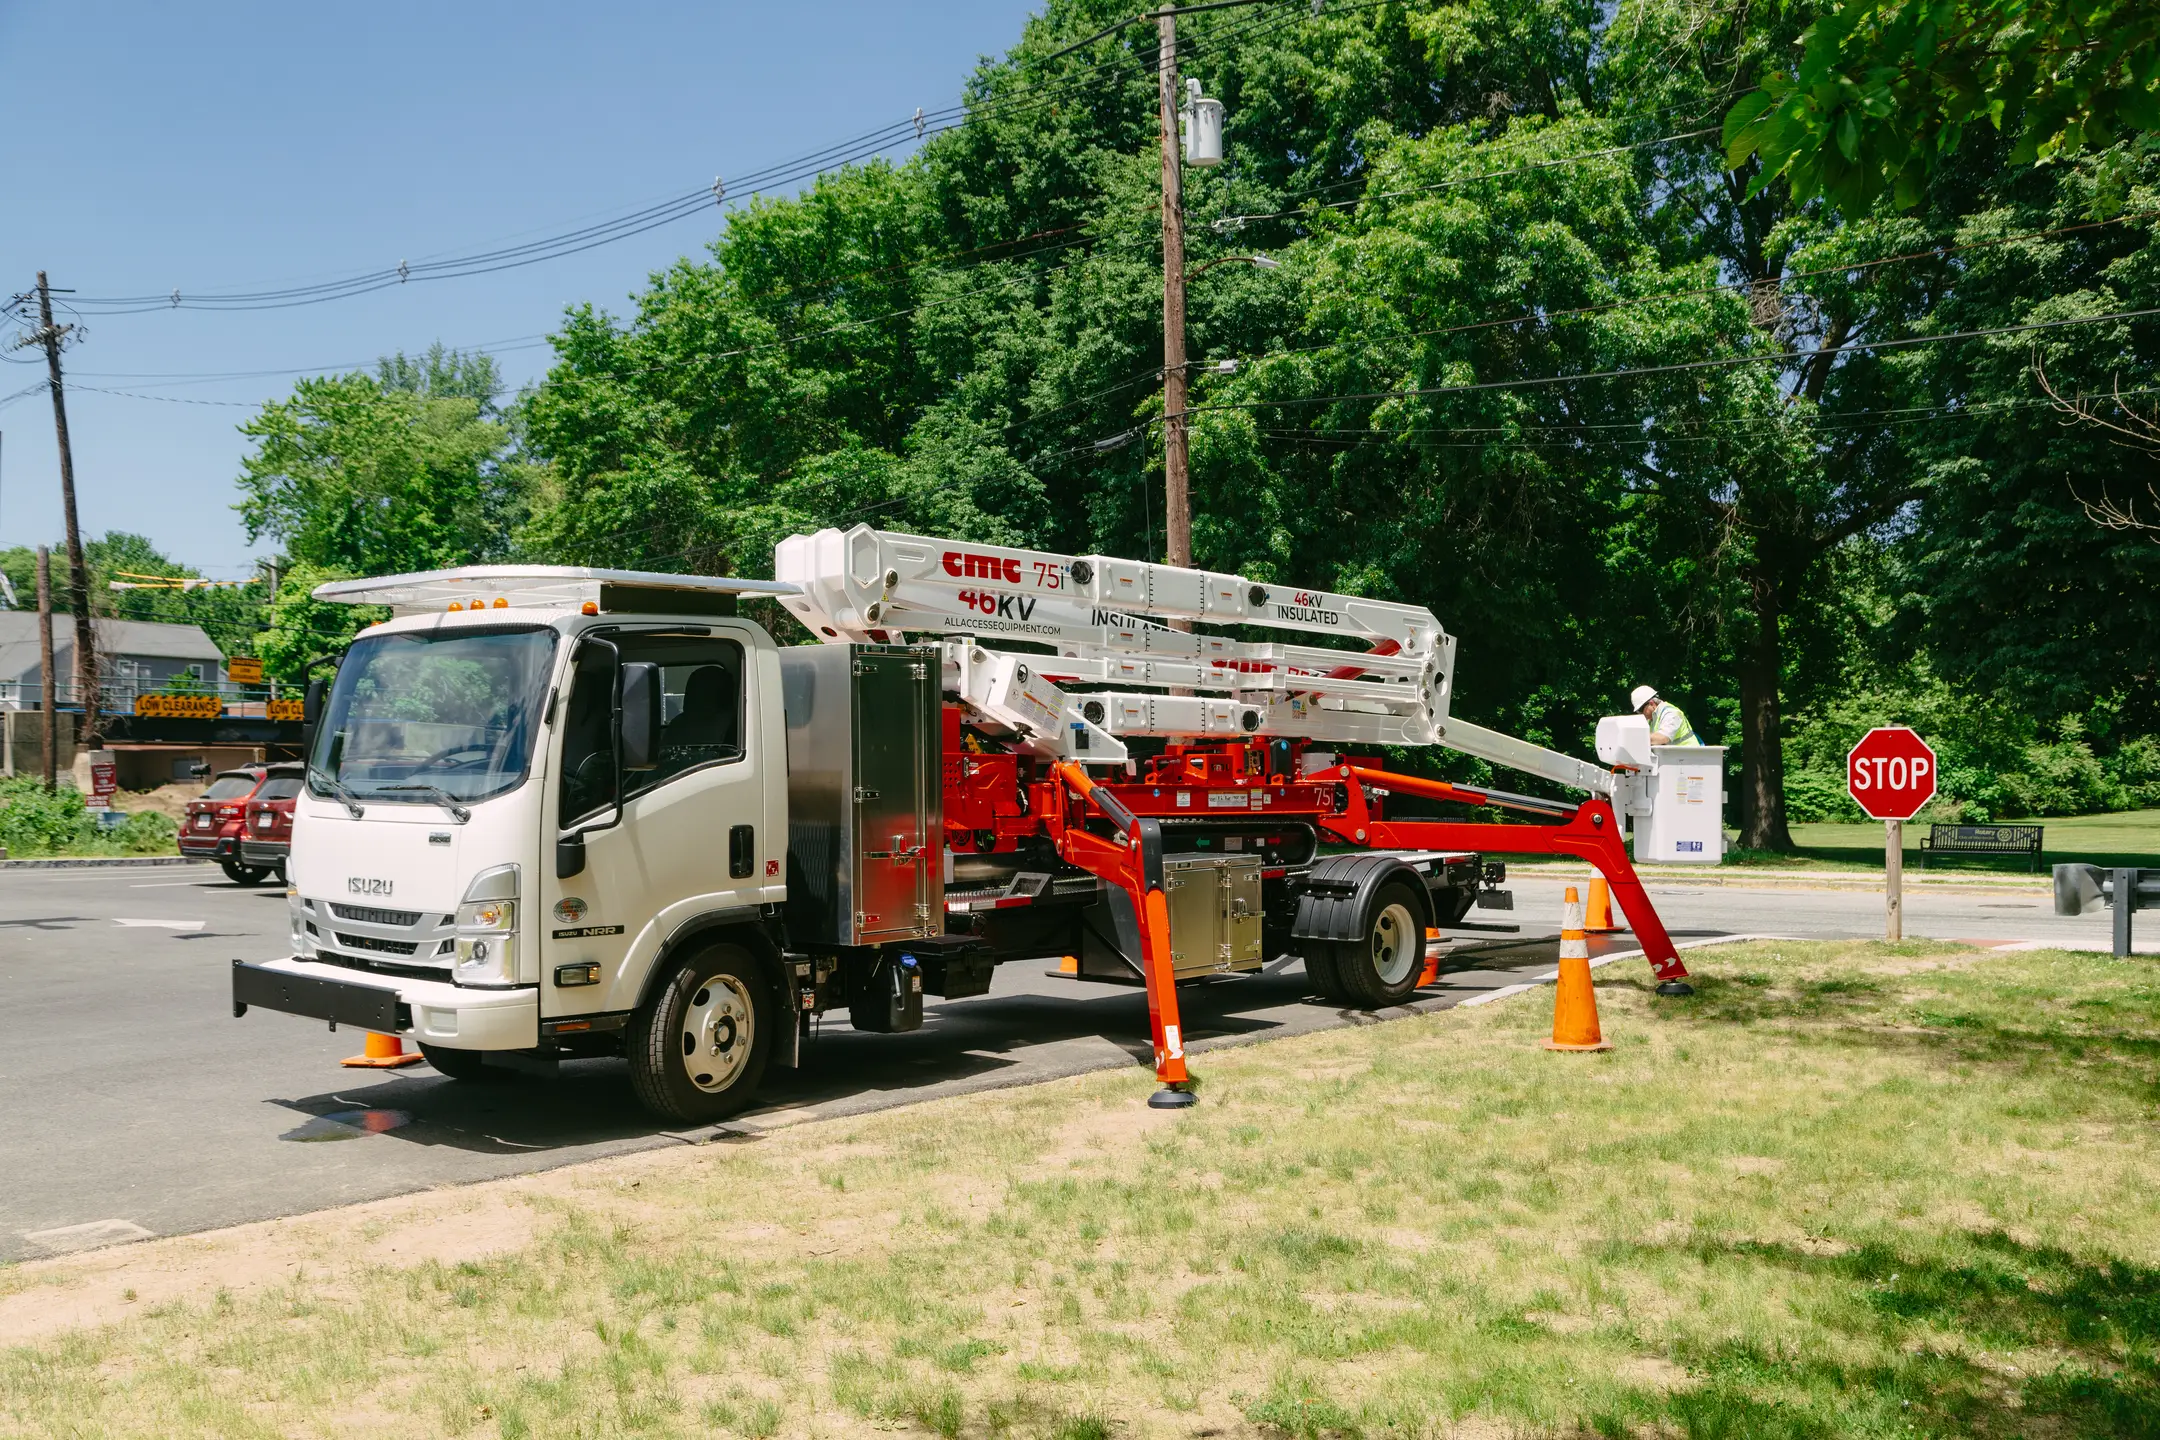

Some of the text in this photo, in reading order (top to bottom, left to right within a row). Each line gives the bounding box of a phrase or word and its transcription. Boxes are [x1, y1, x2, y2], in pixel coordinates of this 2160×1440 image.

[942, 551, 1065, 590] cmc 75i
[1277, 605, 1339, 625] INSULATED
[944, 617, 1061, 636] ALLACCESSEQUIPMENT.COM
[140, 699, 218, 713] LOW CLEARANCE
[270, 703, 289, 715] LOW
[1854, 756, 1930, 791] STOP
[1313, 787, 1334, 806] 75i
[348, 877, 393, 896] ISUZU
[558, 926, 616, 938] ISUZU NRR
